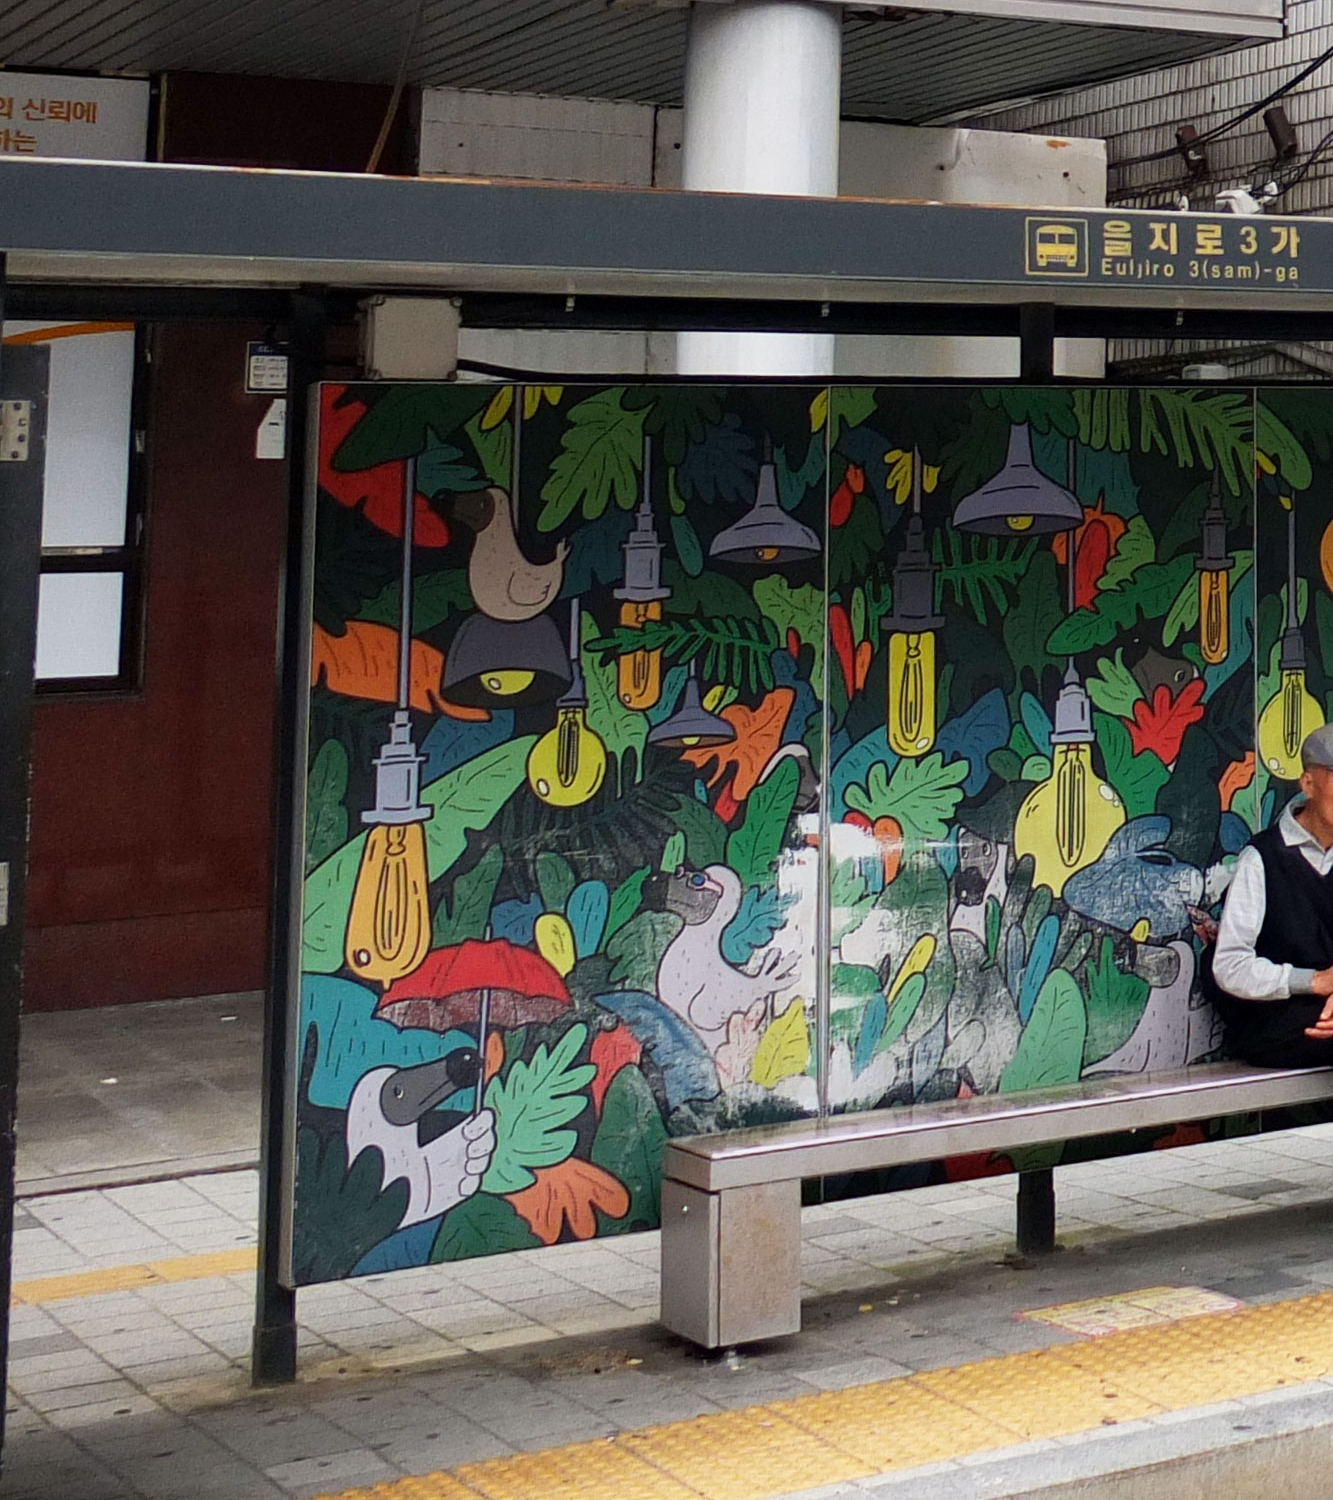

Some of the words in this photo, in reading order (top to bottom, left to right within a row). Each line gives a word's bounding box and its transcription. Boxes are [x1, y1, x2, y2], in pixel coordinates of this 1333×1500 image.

[22, 98, 98, 124] 신뢰에
[1102, 219, 1300, 258] 을지로3가
[1101, 258, 1175, 279] Euljiro
[1189, 260, 1299, 282] 3(sam)-ga
